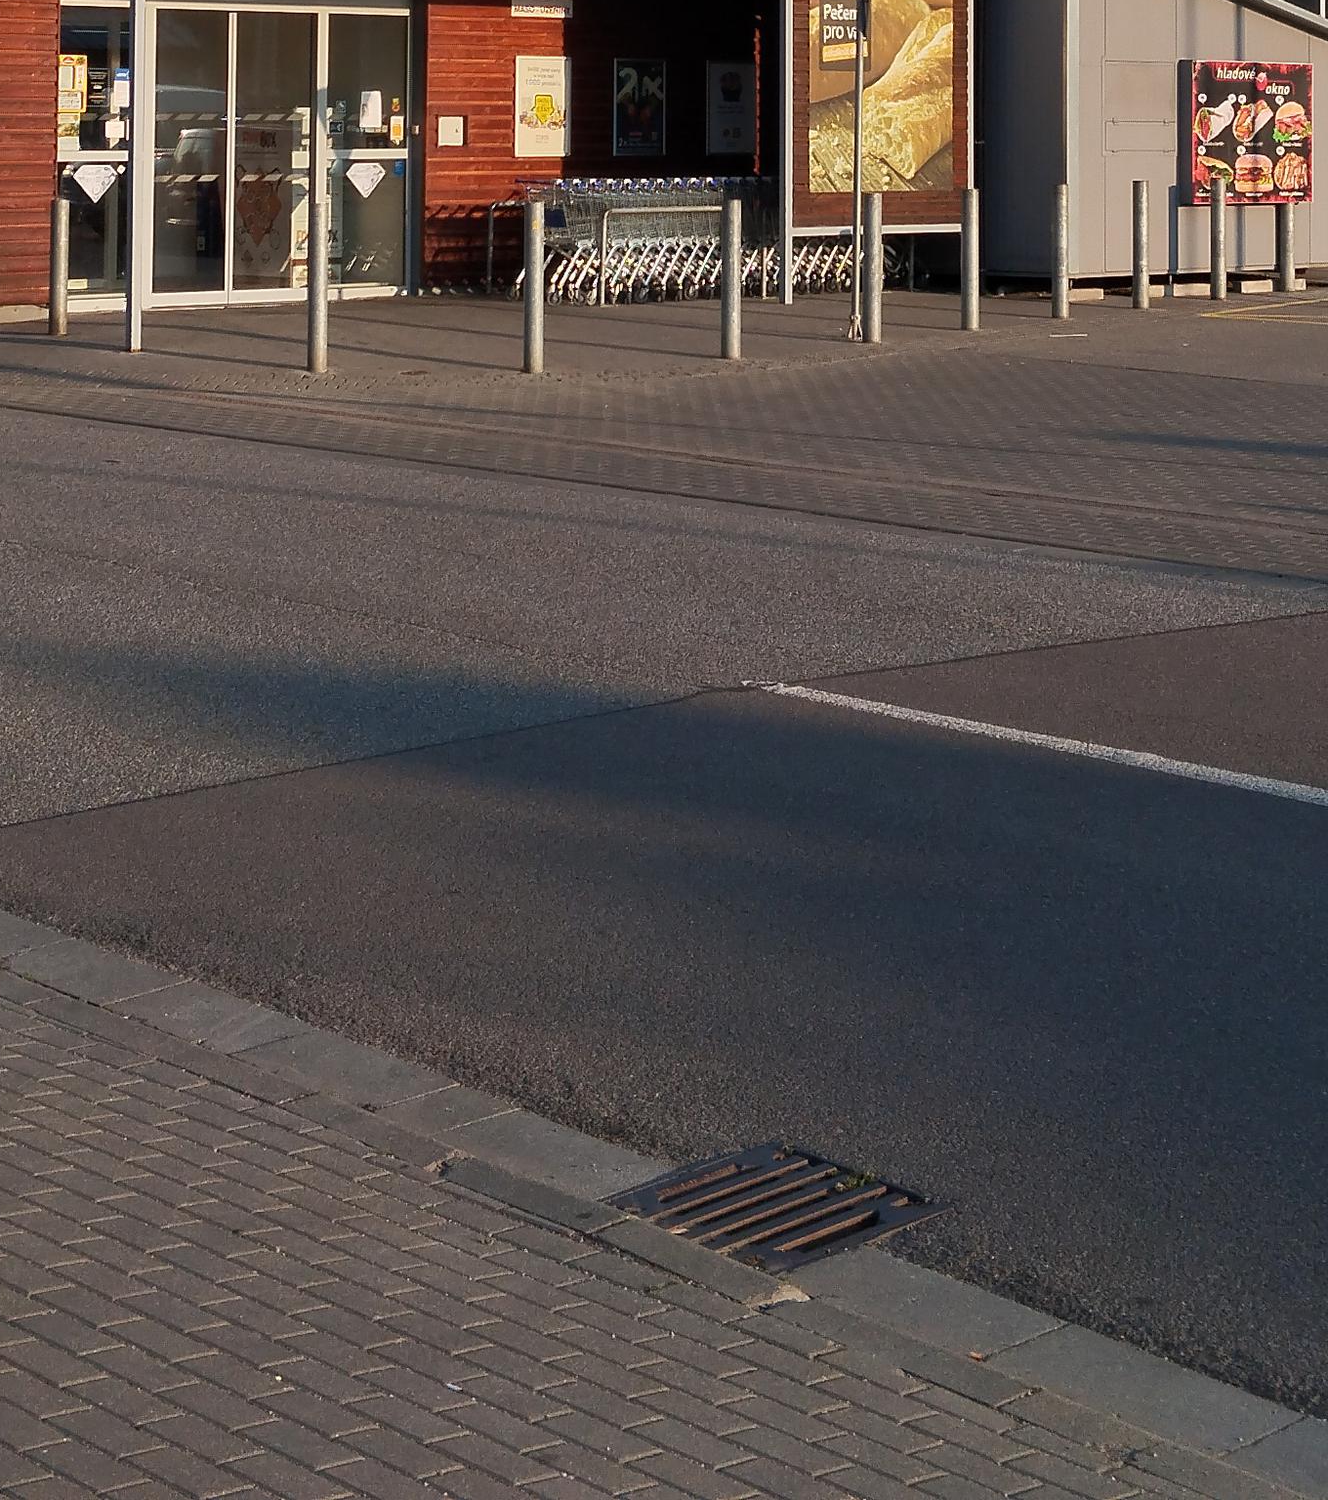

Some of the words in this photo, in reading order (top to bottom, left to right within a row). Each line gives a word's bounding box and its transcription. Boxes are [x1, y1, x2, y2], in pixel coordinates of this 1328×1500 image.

[823, 25, 844, 43] pro
[1216, 67, 1256, 80] hladové
[1265, 83, 1291, 95] okno
